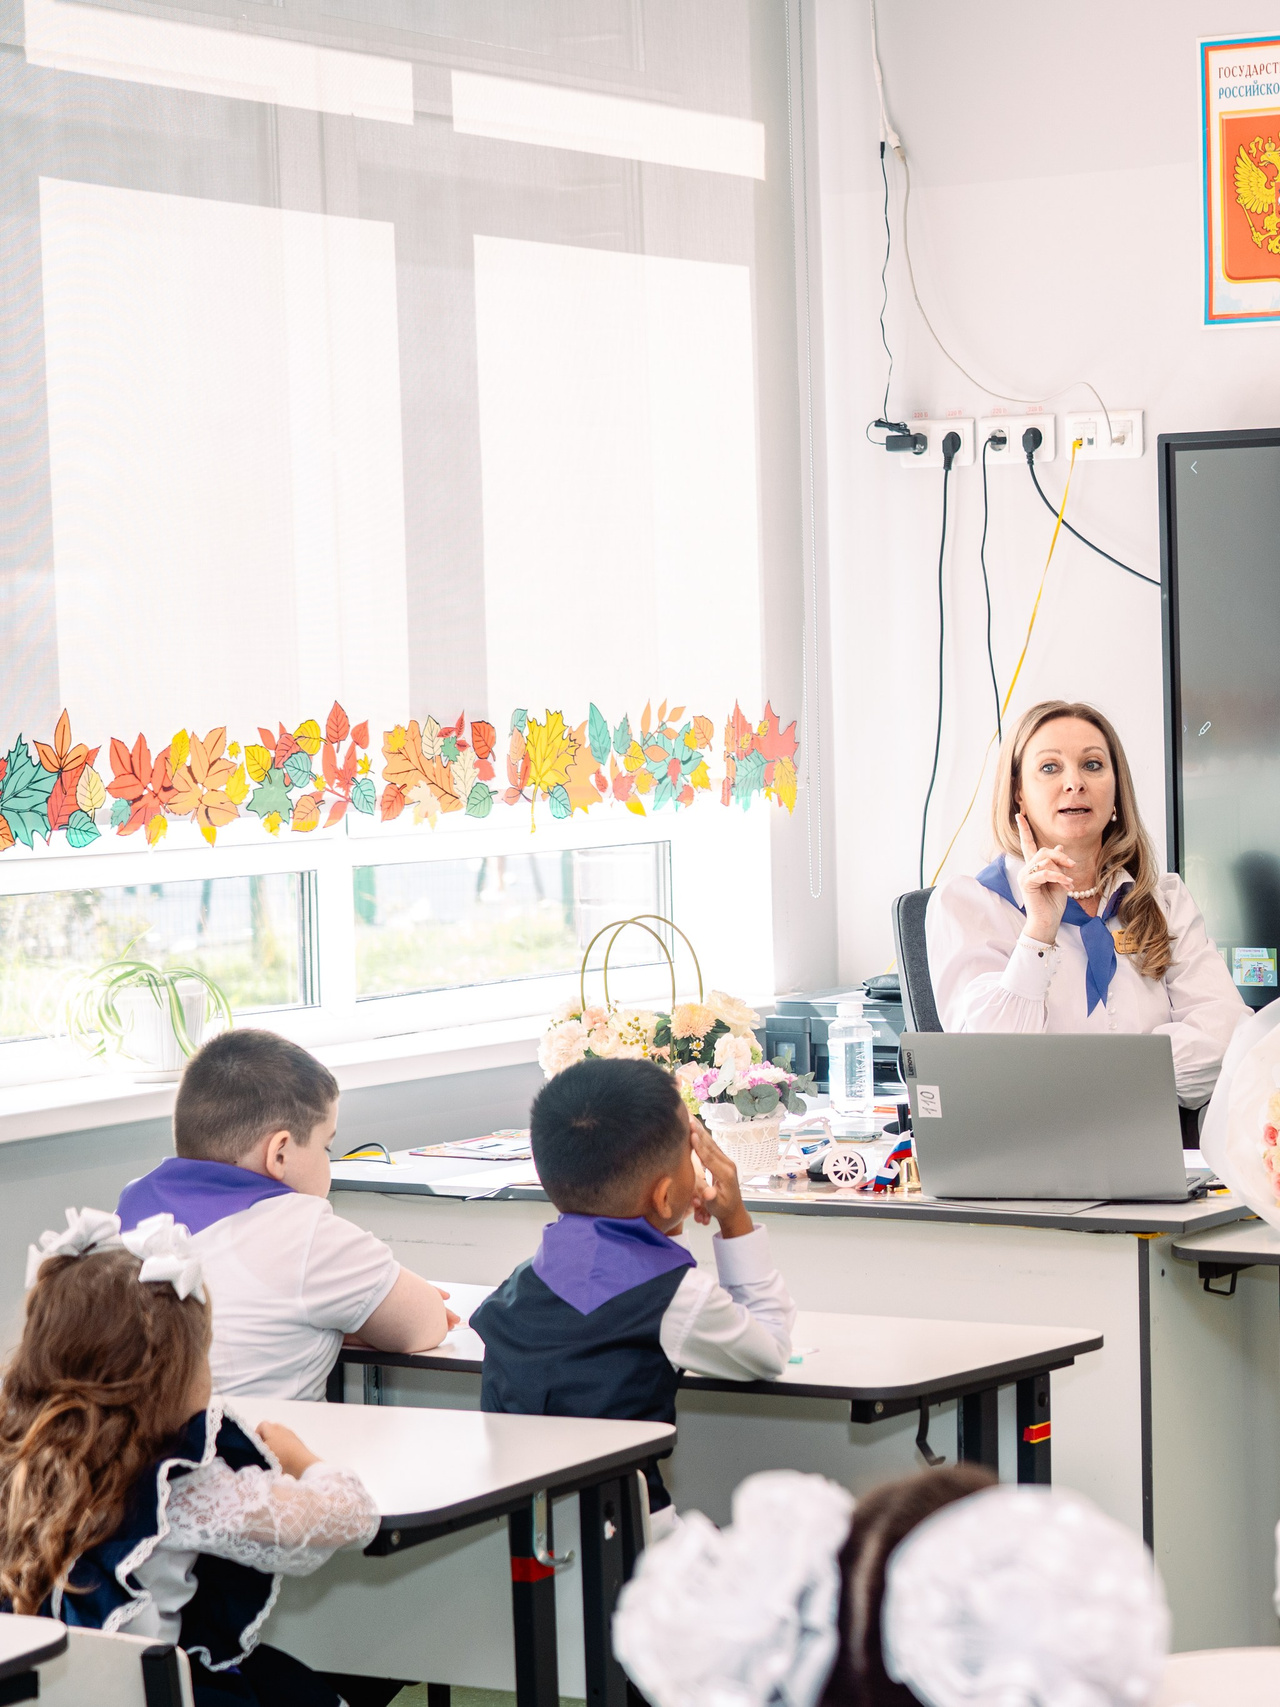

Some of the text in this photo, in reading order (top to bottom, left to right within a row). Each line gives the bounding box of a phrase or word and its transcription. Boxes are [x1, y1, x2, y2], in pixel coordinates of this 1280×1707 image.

[1267, 974, 1273, 983] 2
[906, 1051, 915, 1076] Lenovo
[920, 1090, 937, 1115] 110
